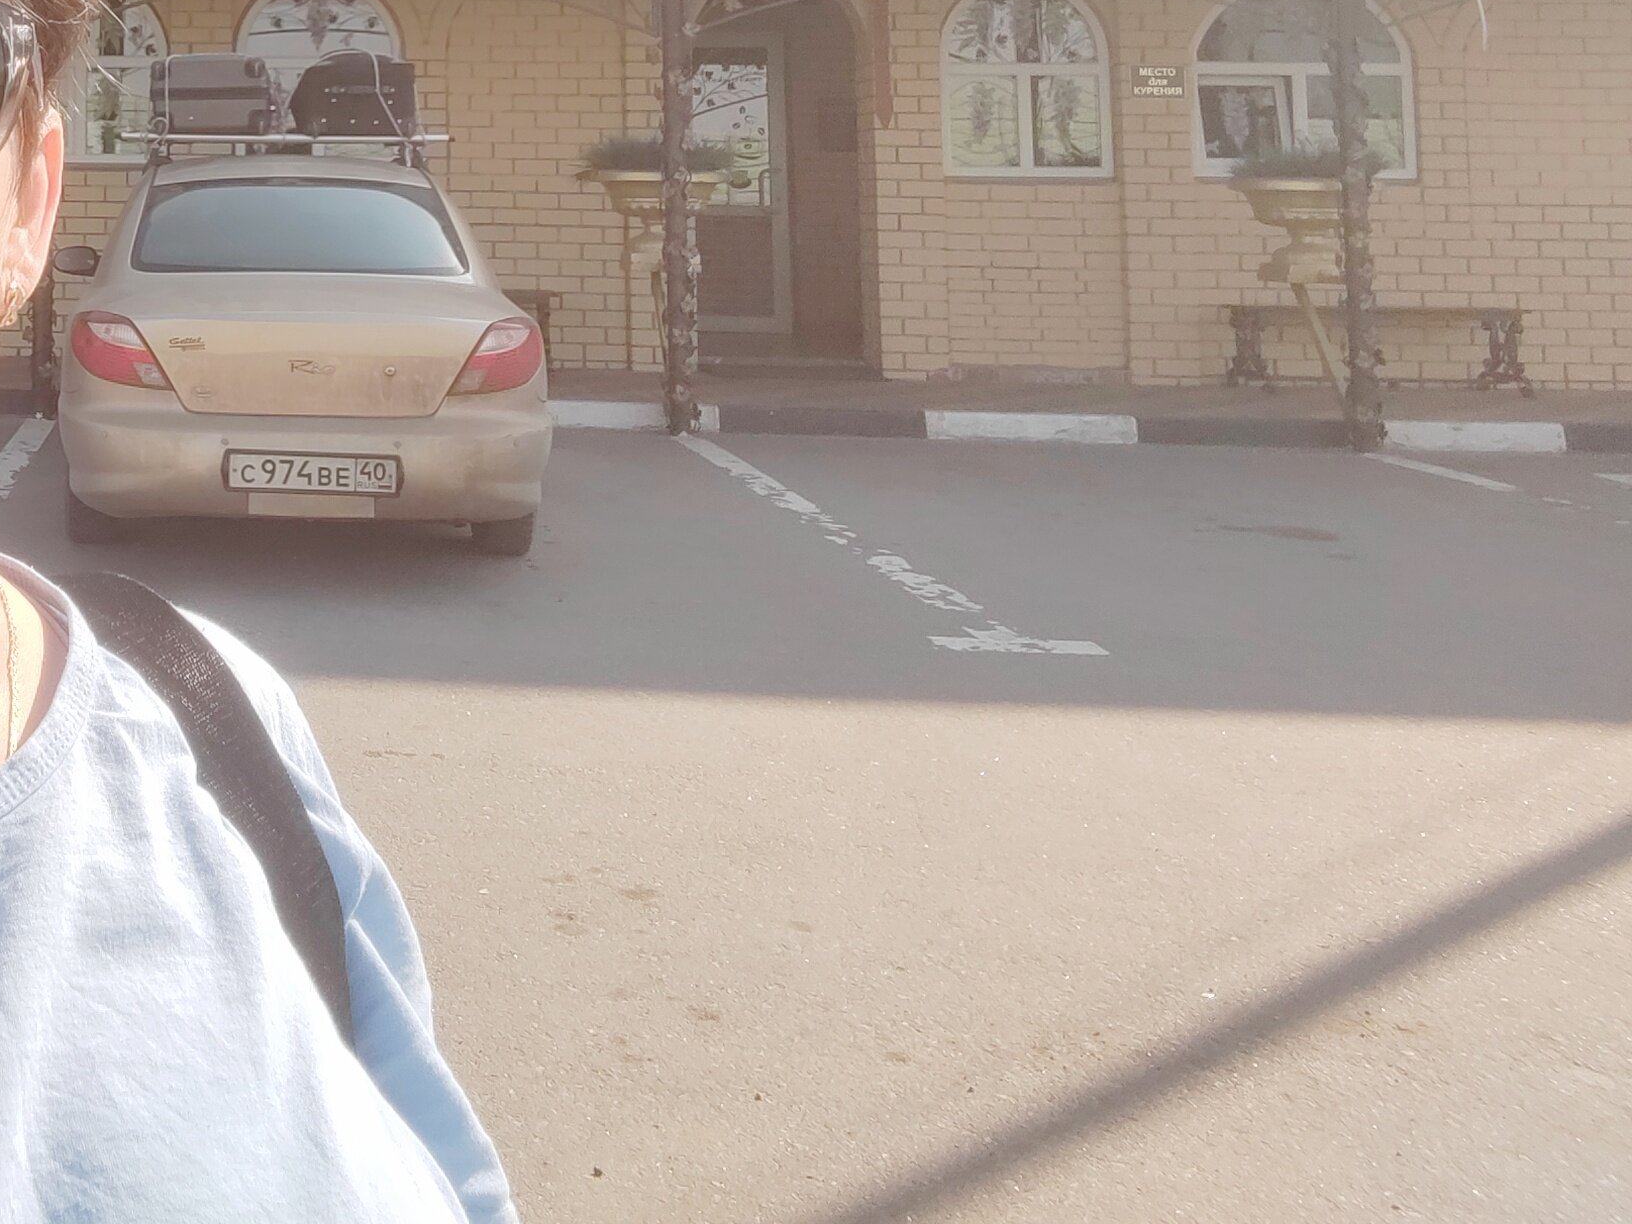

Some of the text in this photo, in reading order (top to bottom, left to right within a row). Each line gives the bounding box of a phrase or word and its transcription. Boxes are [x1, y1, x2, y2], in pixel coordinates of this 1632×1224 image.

[1138, 66, 1177, 77] МЕСТО
[1148, 76, 1169, 86] для
[1133, 86, 1183, 96] КУРЕНИЯ
[359, 461, 387, 482] 40
